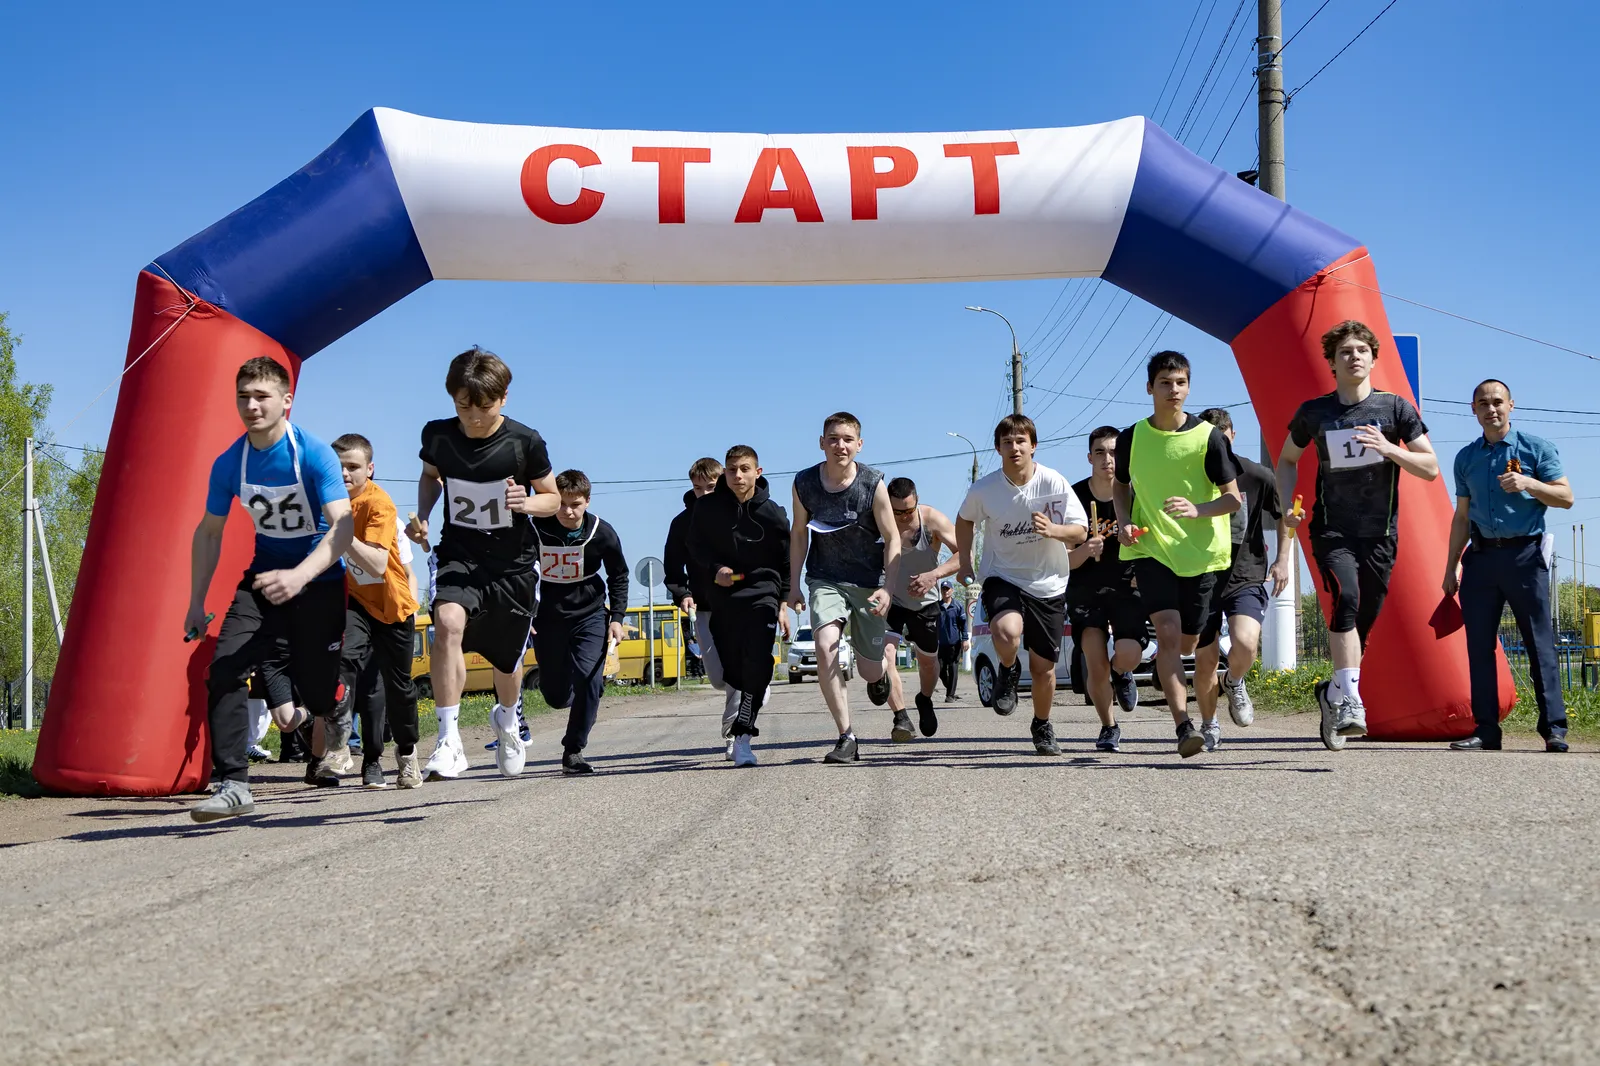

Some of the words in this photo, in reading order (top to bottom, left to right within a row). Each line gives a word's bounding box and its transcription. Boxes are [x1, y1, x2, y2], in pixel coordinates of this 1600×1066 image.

[520, 141, 1020, 224] СТАРТ
[1343, 441, 1368, 459] 17
[249, 493, 305, 532] 26
[453, 496, 500, 525] 21
[1043, 500, 1064, 525] 15
[543, 552, 579, 579] 25
